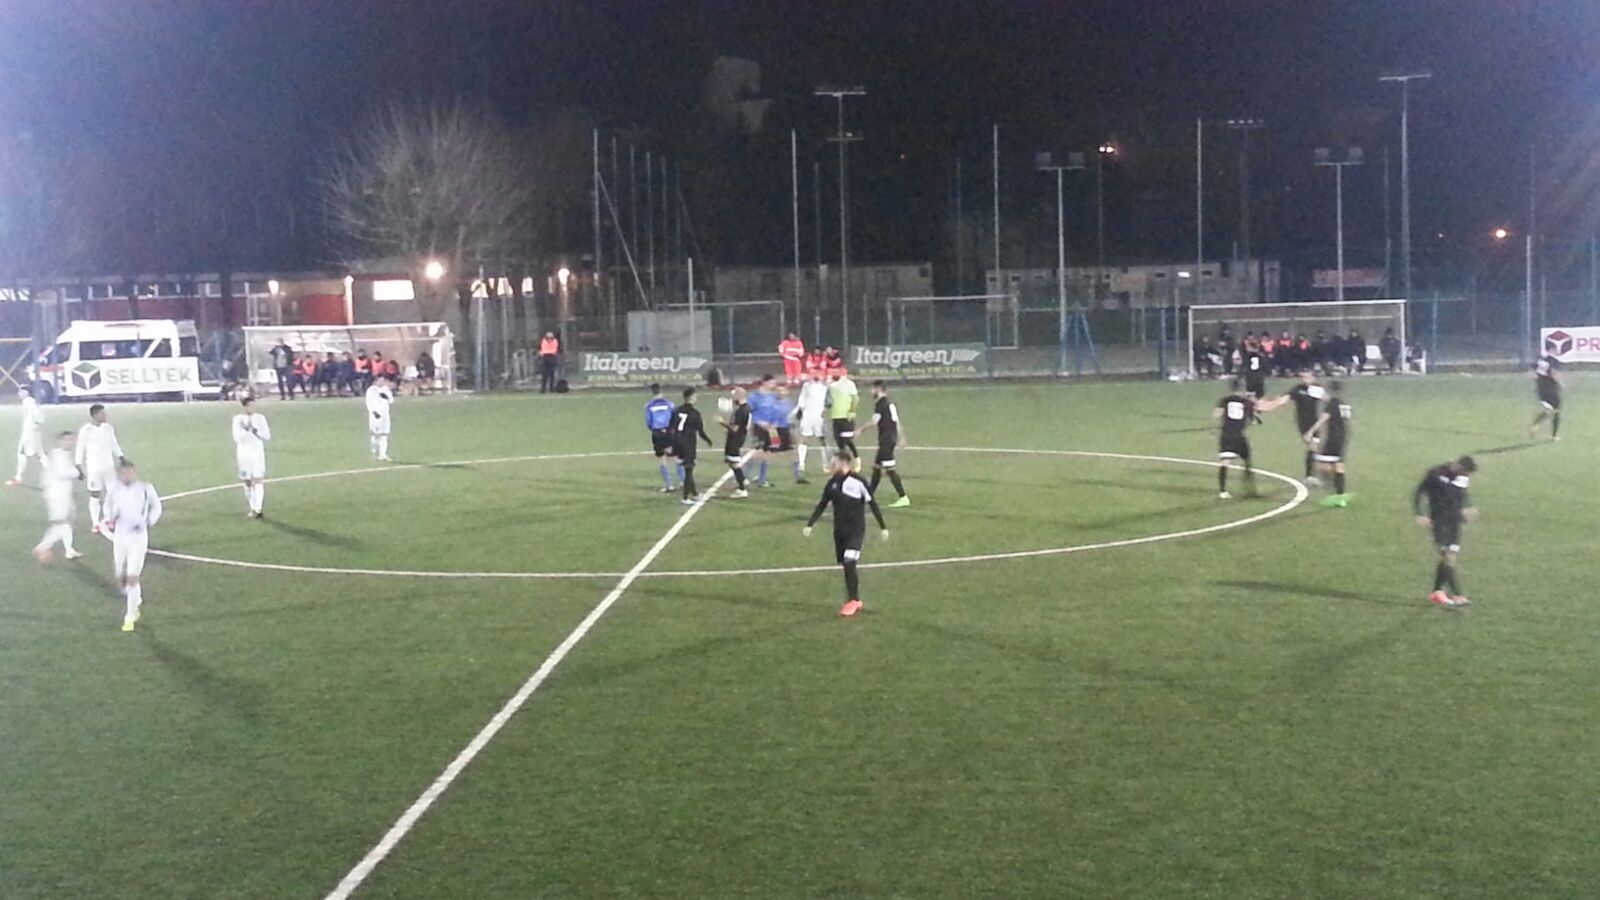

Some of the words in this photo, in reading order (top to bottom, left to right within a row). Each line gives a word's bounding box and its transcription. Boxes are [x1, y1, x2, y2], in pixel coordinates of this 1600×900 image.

[583, 353, 682, 375] Italgreen
[856, 346, 954, 369] Italgreen
[106, 367, 192, 385] SELLTEK
[678, 412, 688, 431] 7
